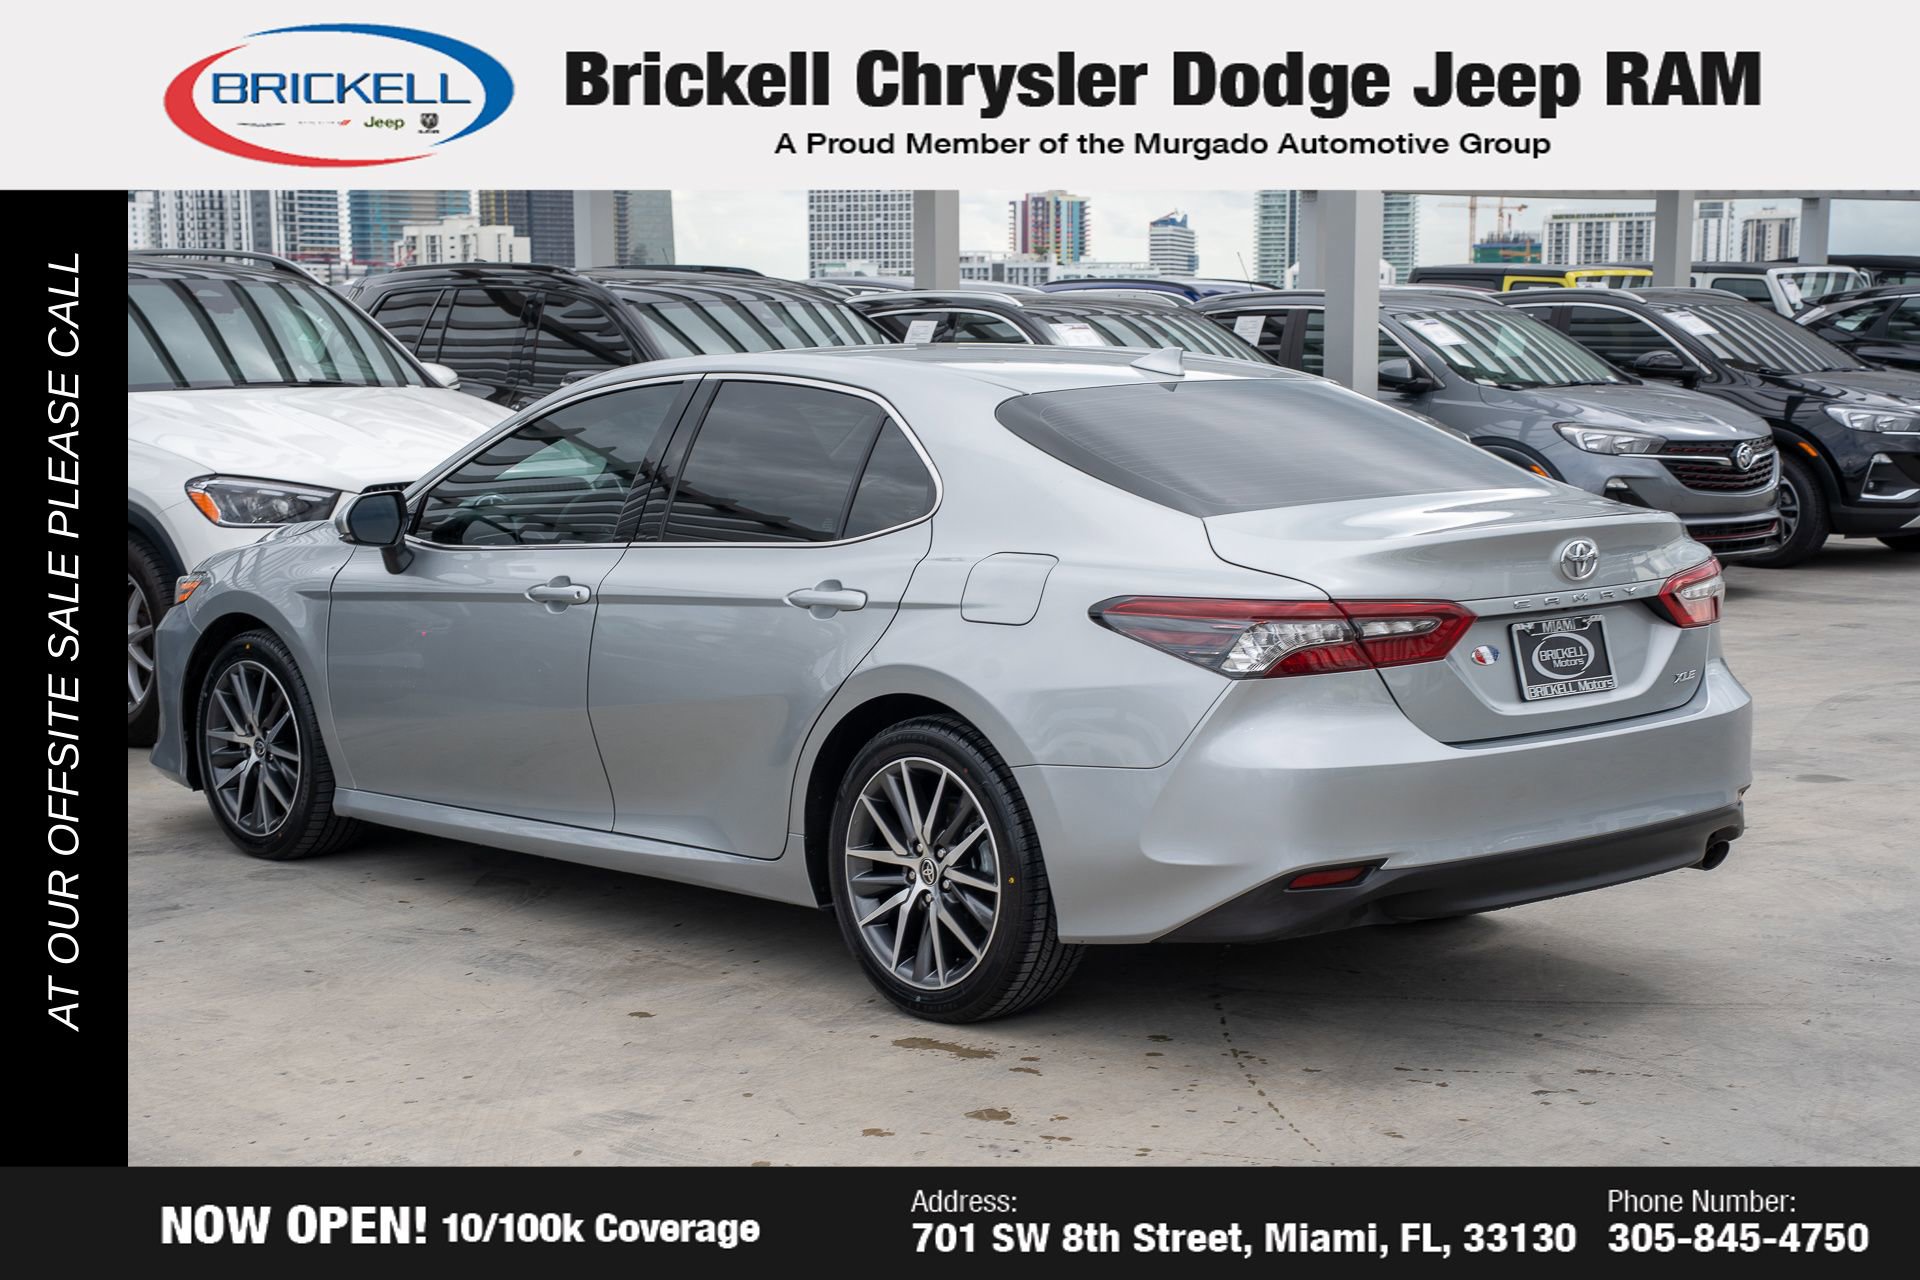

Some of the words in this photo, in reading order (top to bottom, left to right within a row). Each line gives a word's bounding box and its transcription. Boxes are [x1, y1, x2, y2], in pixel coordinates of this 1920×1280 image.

[1513, 586, 1637, 609] CAMRY
[1542, 619, 1576, 633] MIAMI
[1539, 646, 1588, 662] BRICKELL
[1552, 657, 1585, 668] Motors
[1673, 669, 1697, 684] XLE
[1528, 681, 1577, 698] BRICKELL
[1577, 678, 1614, 692] Motors
